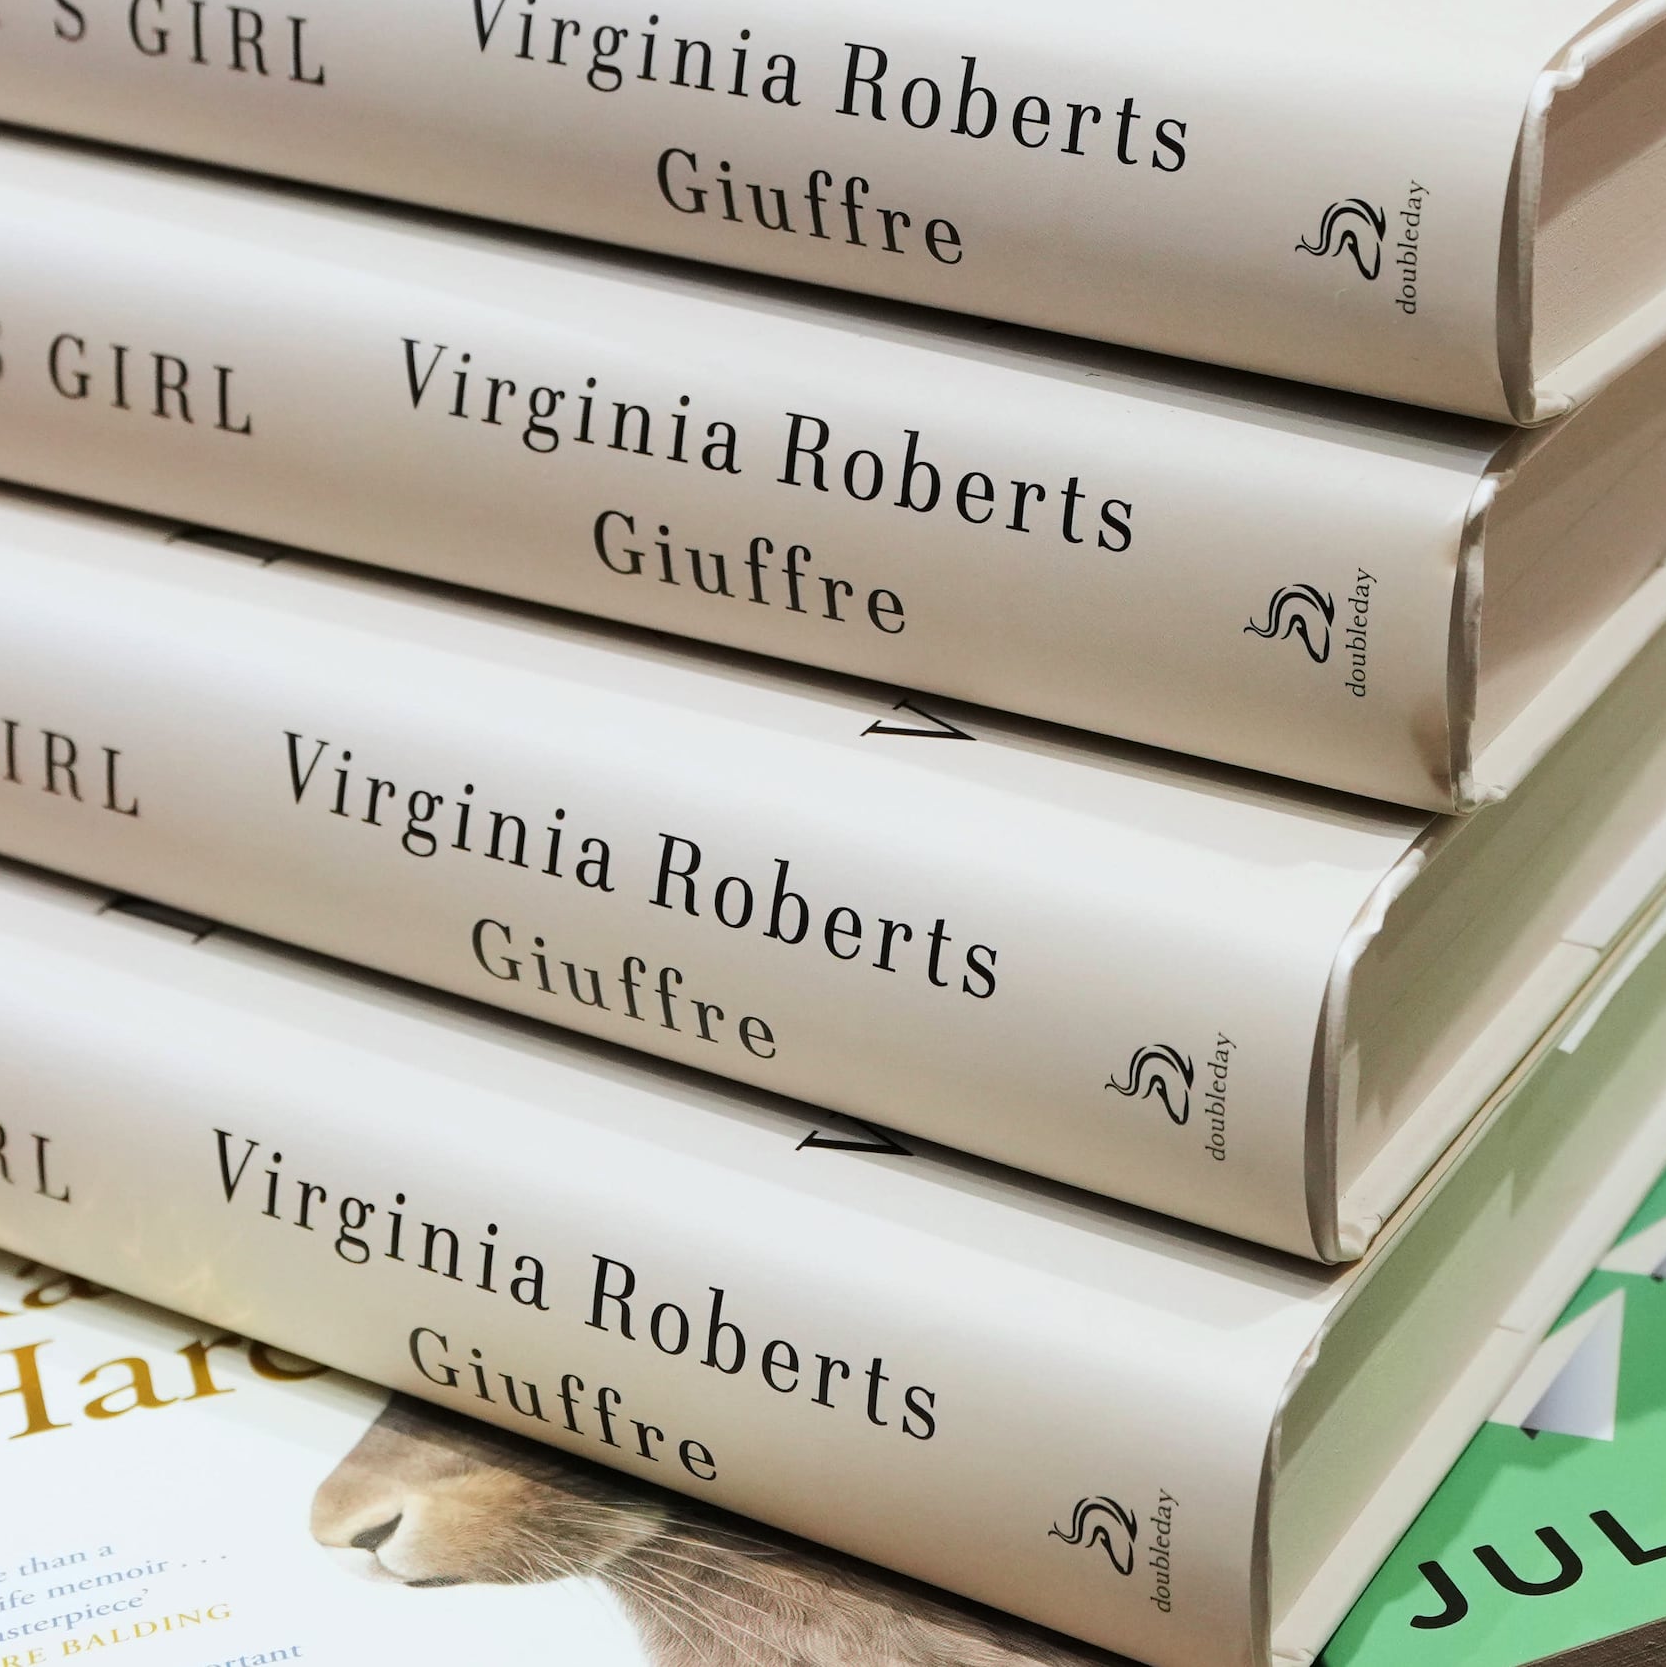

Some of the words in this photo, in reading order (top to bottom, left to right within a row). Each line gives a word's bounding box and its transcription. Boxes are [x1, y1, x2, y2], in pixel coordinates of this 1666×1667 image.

[835, 42, 1189, 174] Roberts
[656, 146, 967, 266] Giuffre
[1394, 178, 1431, 316] doubleday
[48, 332, 253, 436] GIRL
[401, 337, 743, 476] Virginia
[776, 412, 1135, 554] Roberts
[592, 509, 908, 635] Giuffre
[1344, 566, 1378, 698] doubleday
[281, 730, 616, 894] Virginia
[648, 832, 999, 1000] Roberts
[471, 916, 779, 1060] Giuffre
[1204, 1030, 1239, 1163] doubleday
[211, 1127, 551, 1312] Virginia
[583, 1252, 937, 1442] Roberts
[408, 1325, 719, 1484] Giuffre
[18, 1551, 88, 1579] than
[97, 1544, 117, 1559] a
[46, 1559, 171, 1602] memoir
[1148, 1487, 1181, 1615] doubleday
[60, 1602, 233, 1658] BALDING
